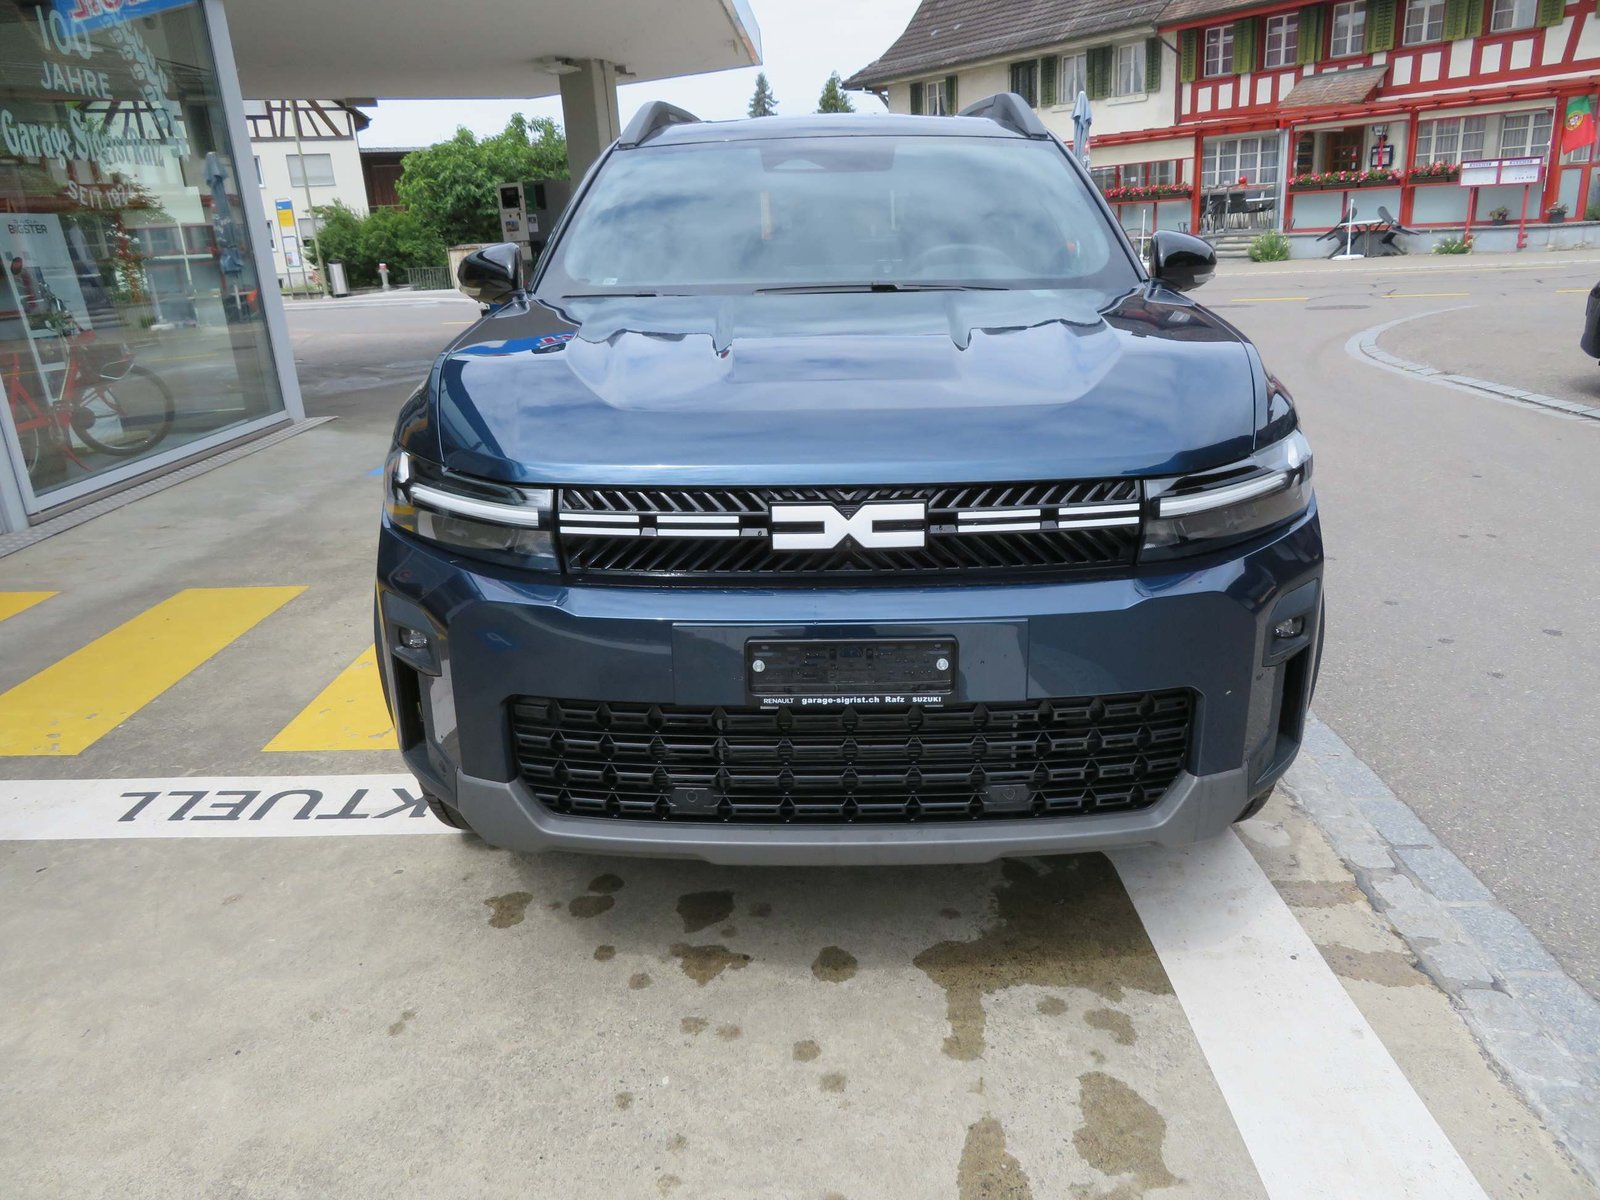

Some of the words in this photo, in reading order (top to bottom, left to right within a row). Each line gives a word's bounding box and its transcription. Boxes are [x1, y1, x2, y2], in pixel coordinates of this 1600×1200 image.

[35, 5, 93, 60] 100
[40, 60, 114, 100] JAHRE
[1, 109, 74, 169] Garage
[66, 179, 103, 210] SEIT
[8, 224, 49, 234] BIGSTER
[801, 696, 880, 705] garage-sigrist.ch
